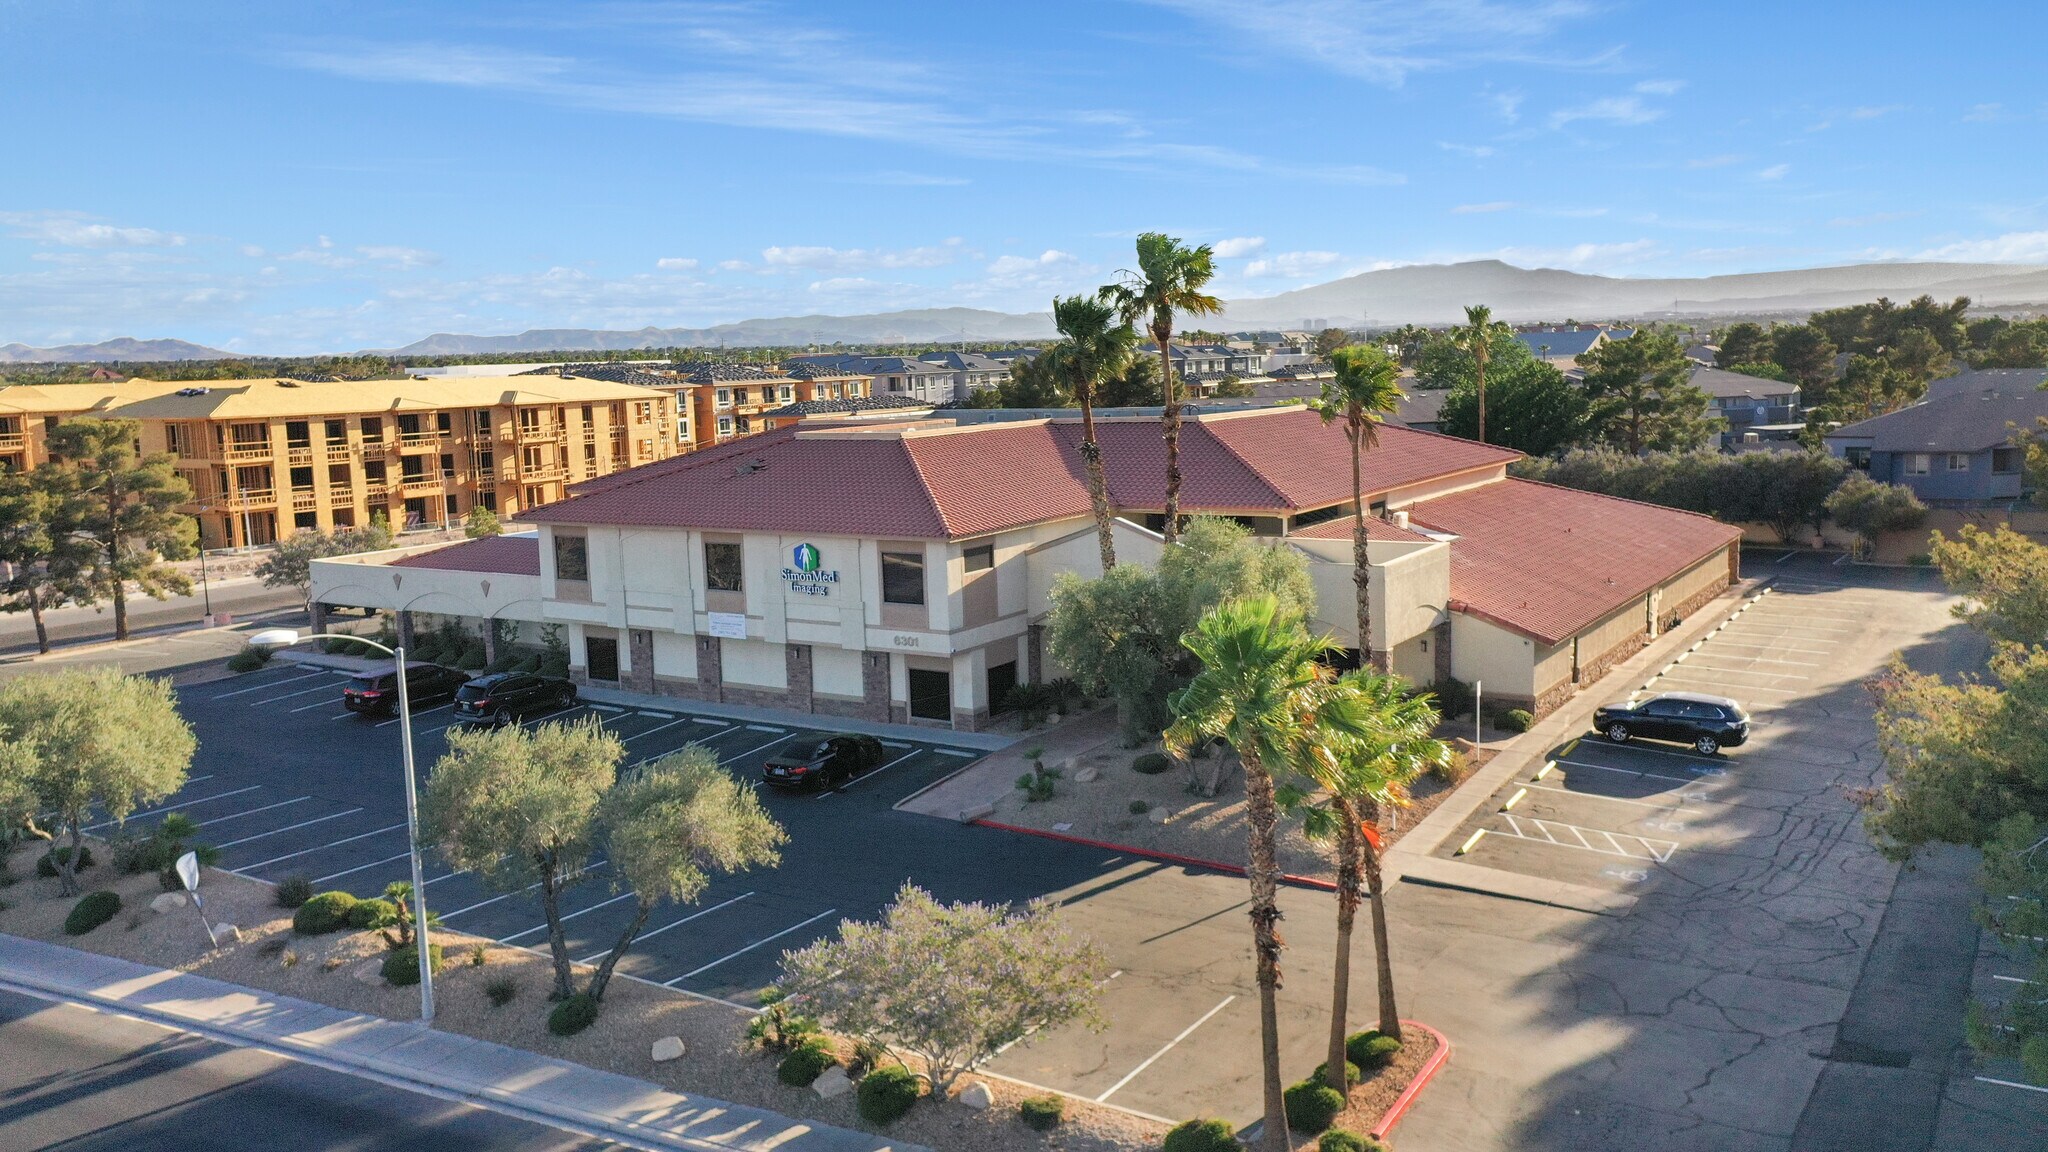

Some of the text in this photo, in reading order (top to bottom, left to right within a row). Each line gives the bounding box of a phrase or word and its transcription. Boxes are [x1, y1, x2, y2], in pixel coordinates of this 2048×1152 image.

[781, 568, 836, 583] SimonMed
[790, 581, 827, 596] Imaging
[893, 635, 919, 648] 6301
